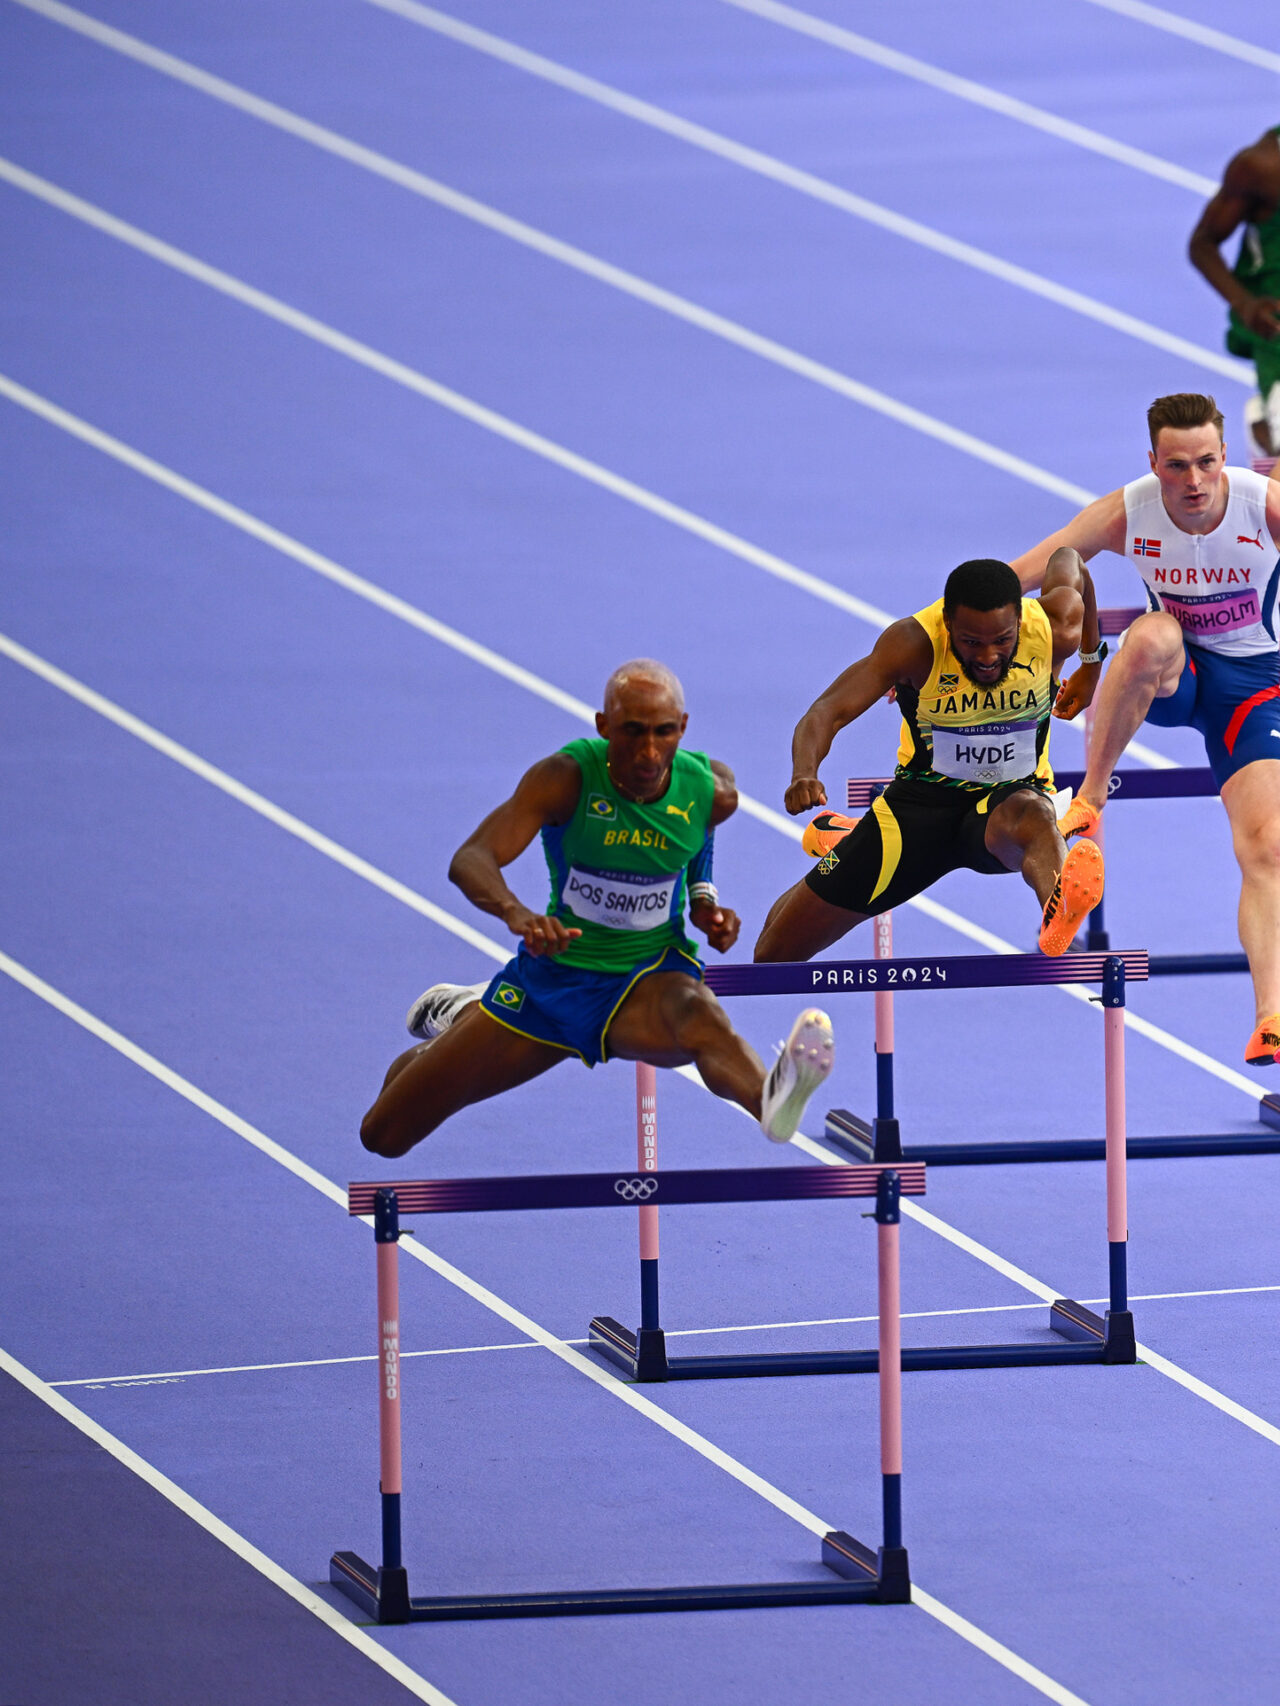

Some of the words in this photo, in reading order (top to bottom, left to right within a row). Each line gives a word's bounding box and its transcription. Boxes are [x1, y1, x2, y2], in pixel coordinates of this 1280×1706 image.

[1154, 567, 1251, 585] NORWAY
[928, 689, 1038, 714] JAMAICA
[987, 725, 1011, 733] 2024
[955, 742, 1015, 764] HYDE
[603, 828, 669, 851] BRASIL
[569, 876, 603, 905] DOS
[604, 890, 668, 913] SANTOS
[876, 914, 891, 960] MOND
[887, 966, 947, 984] 2024
[641, 1112, 656, 1172] MONDO
[383, 1338, 398, 1400] MONDO
